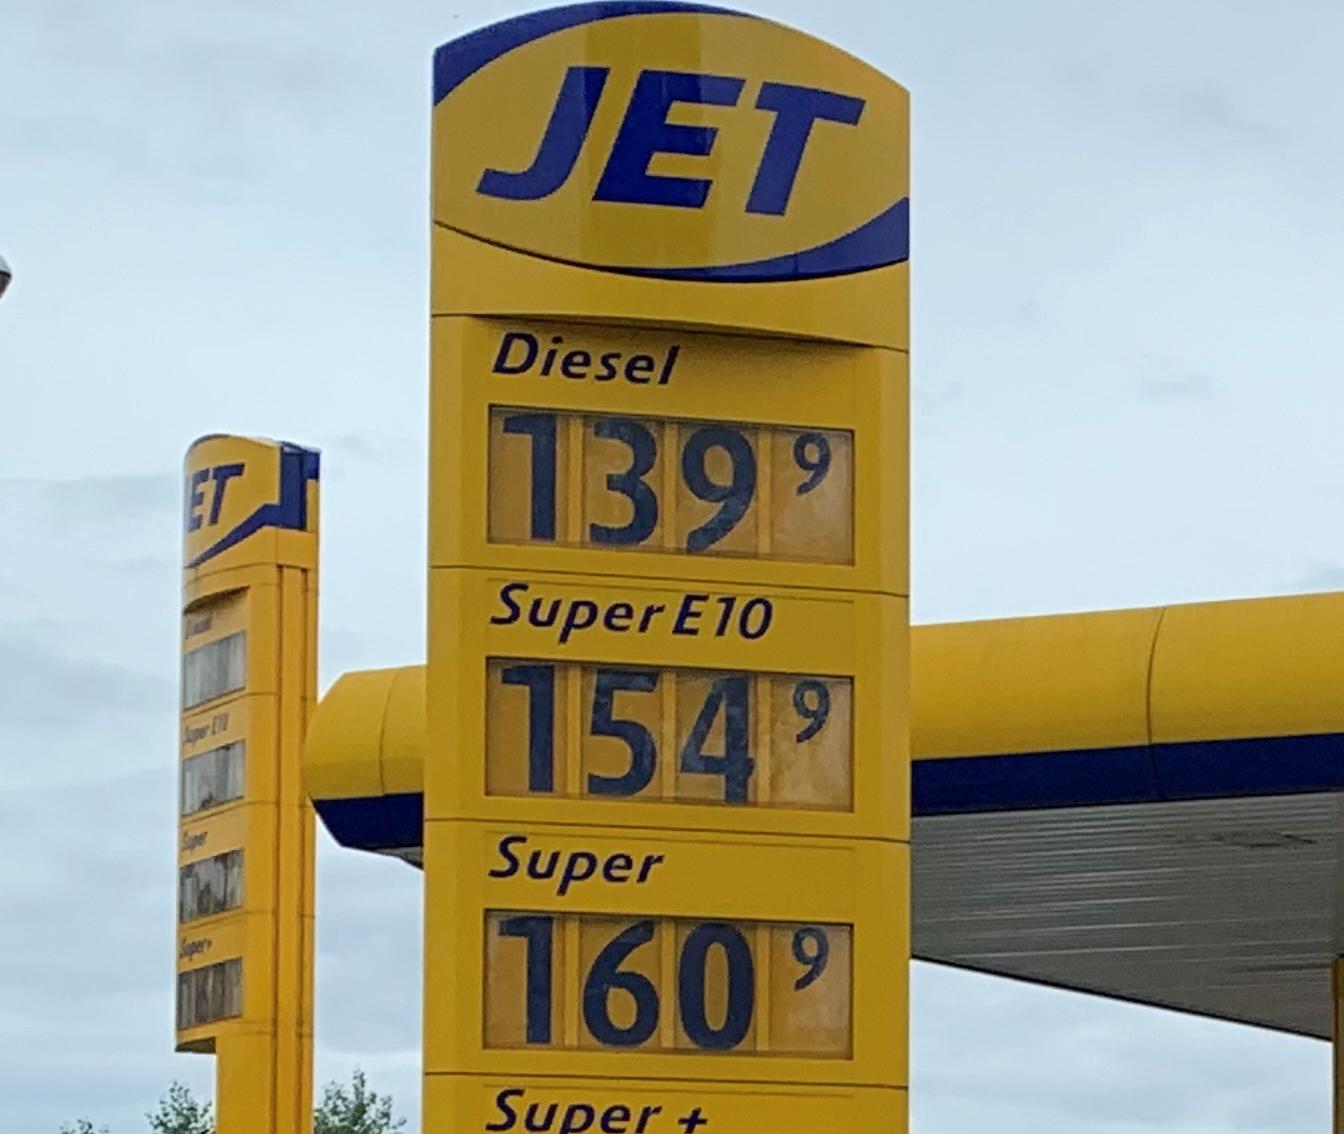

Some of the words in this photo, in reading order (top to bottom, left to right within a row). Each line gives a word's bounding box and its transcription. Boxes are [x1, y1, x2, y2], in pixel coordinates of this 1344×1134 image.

[475, 65, 867, 217] JET
[491, 330, 682, 386] Diesel
[187, 463, 246, 534] ET
[490, 582, 666, 645] Super
[671, 593, 774, 640] E10
[488, 834, 667, 897] Super
